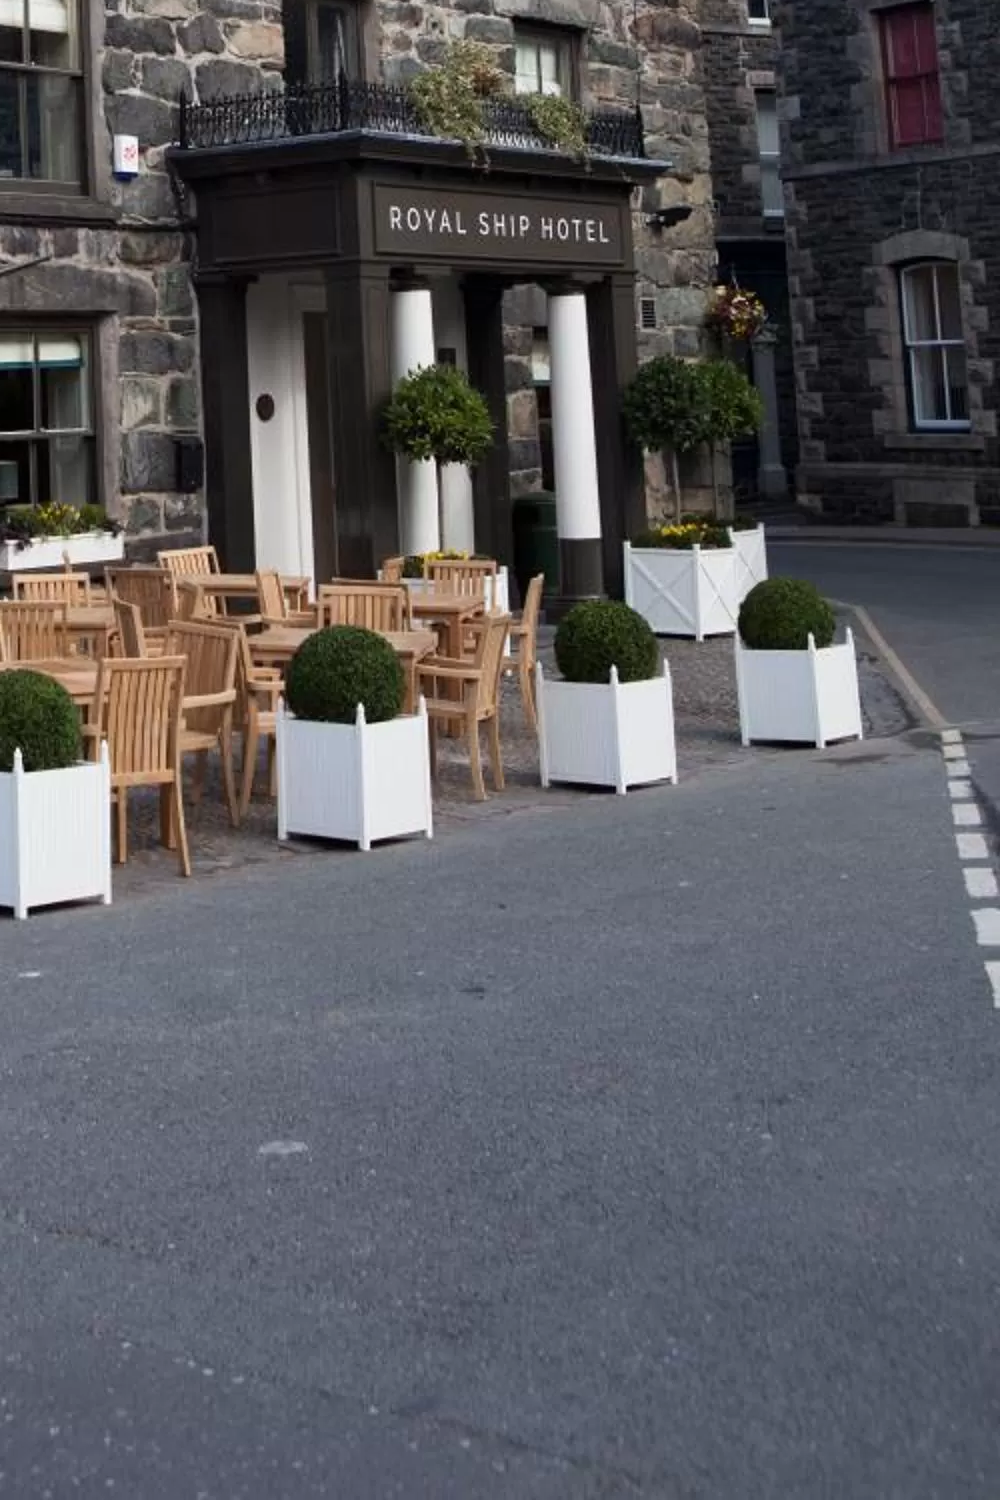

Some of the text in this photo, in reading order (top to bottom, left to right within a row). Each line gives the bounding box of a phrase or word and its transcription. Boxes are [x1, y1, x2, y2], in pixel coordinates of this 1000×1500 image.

[389, 206, 609, 243] ROYAL SHIP HOTEL
